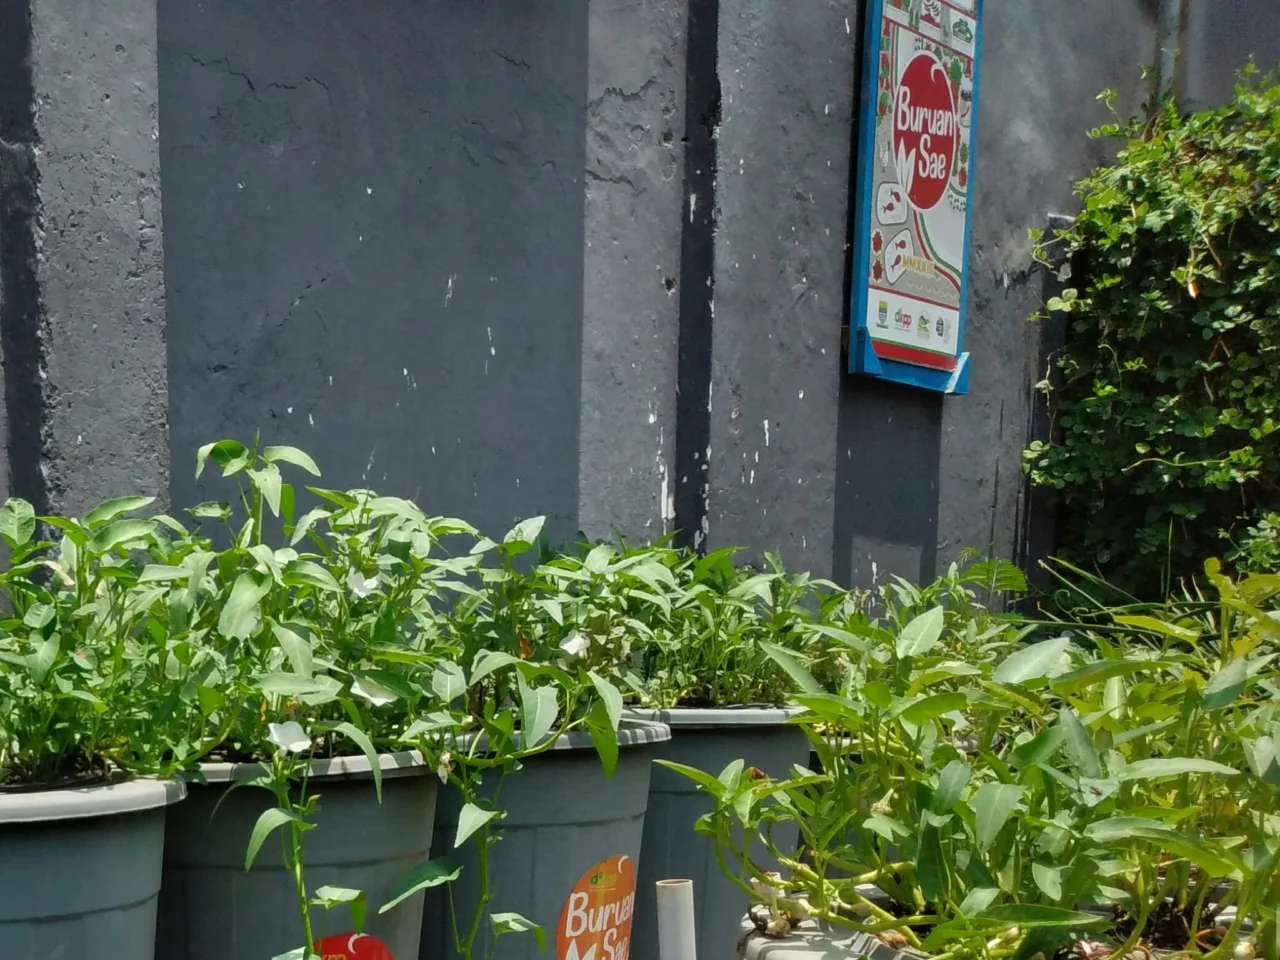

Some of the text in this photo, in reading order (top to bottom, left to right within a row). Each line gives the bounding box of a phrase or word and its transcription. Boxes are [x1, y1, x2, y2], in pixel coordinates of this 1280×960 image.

[897, 85, 952, 137] Buruan
[919, 133, 946, 179] Sae
[565, 891, 635, 938] Buruan
